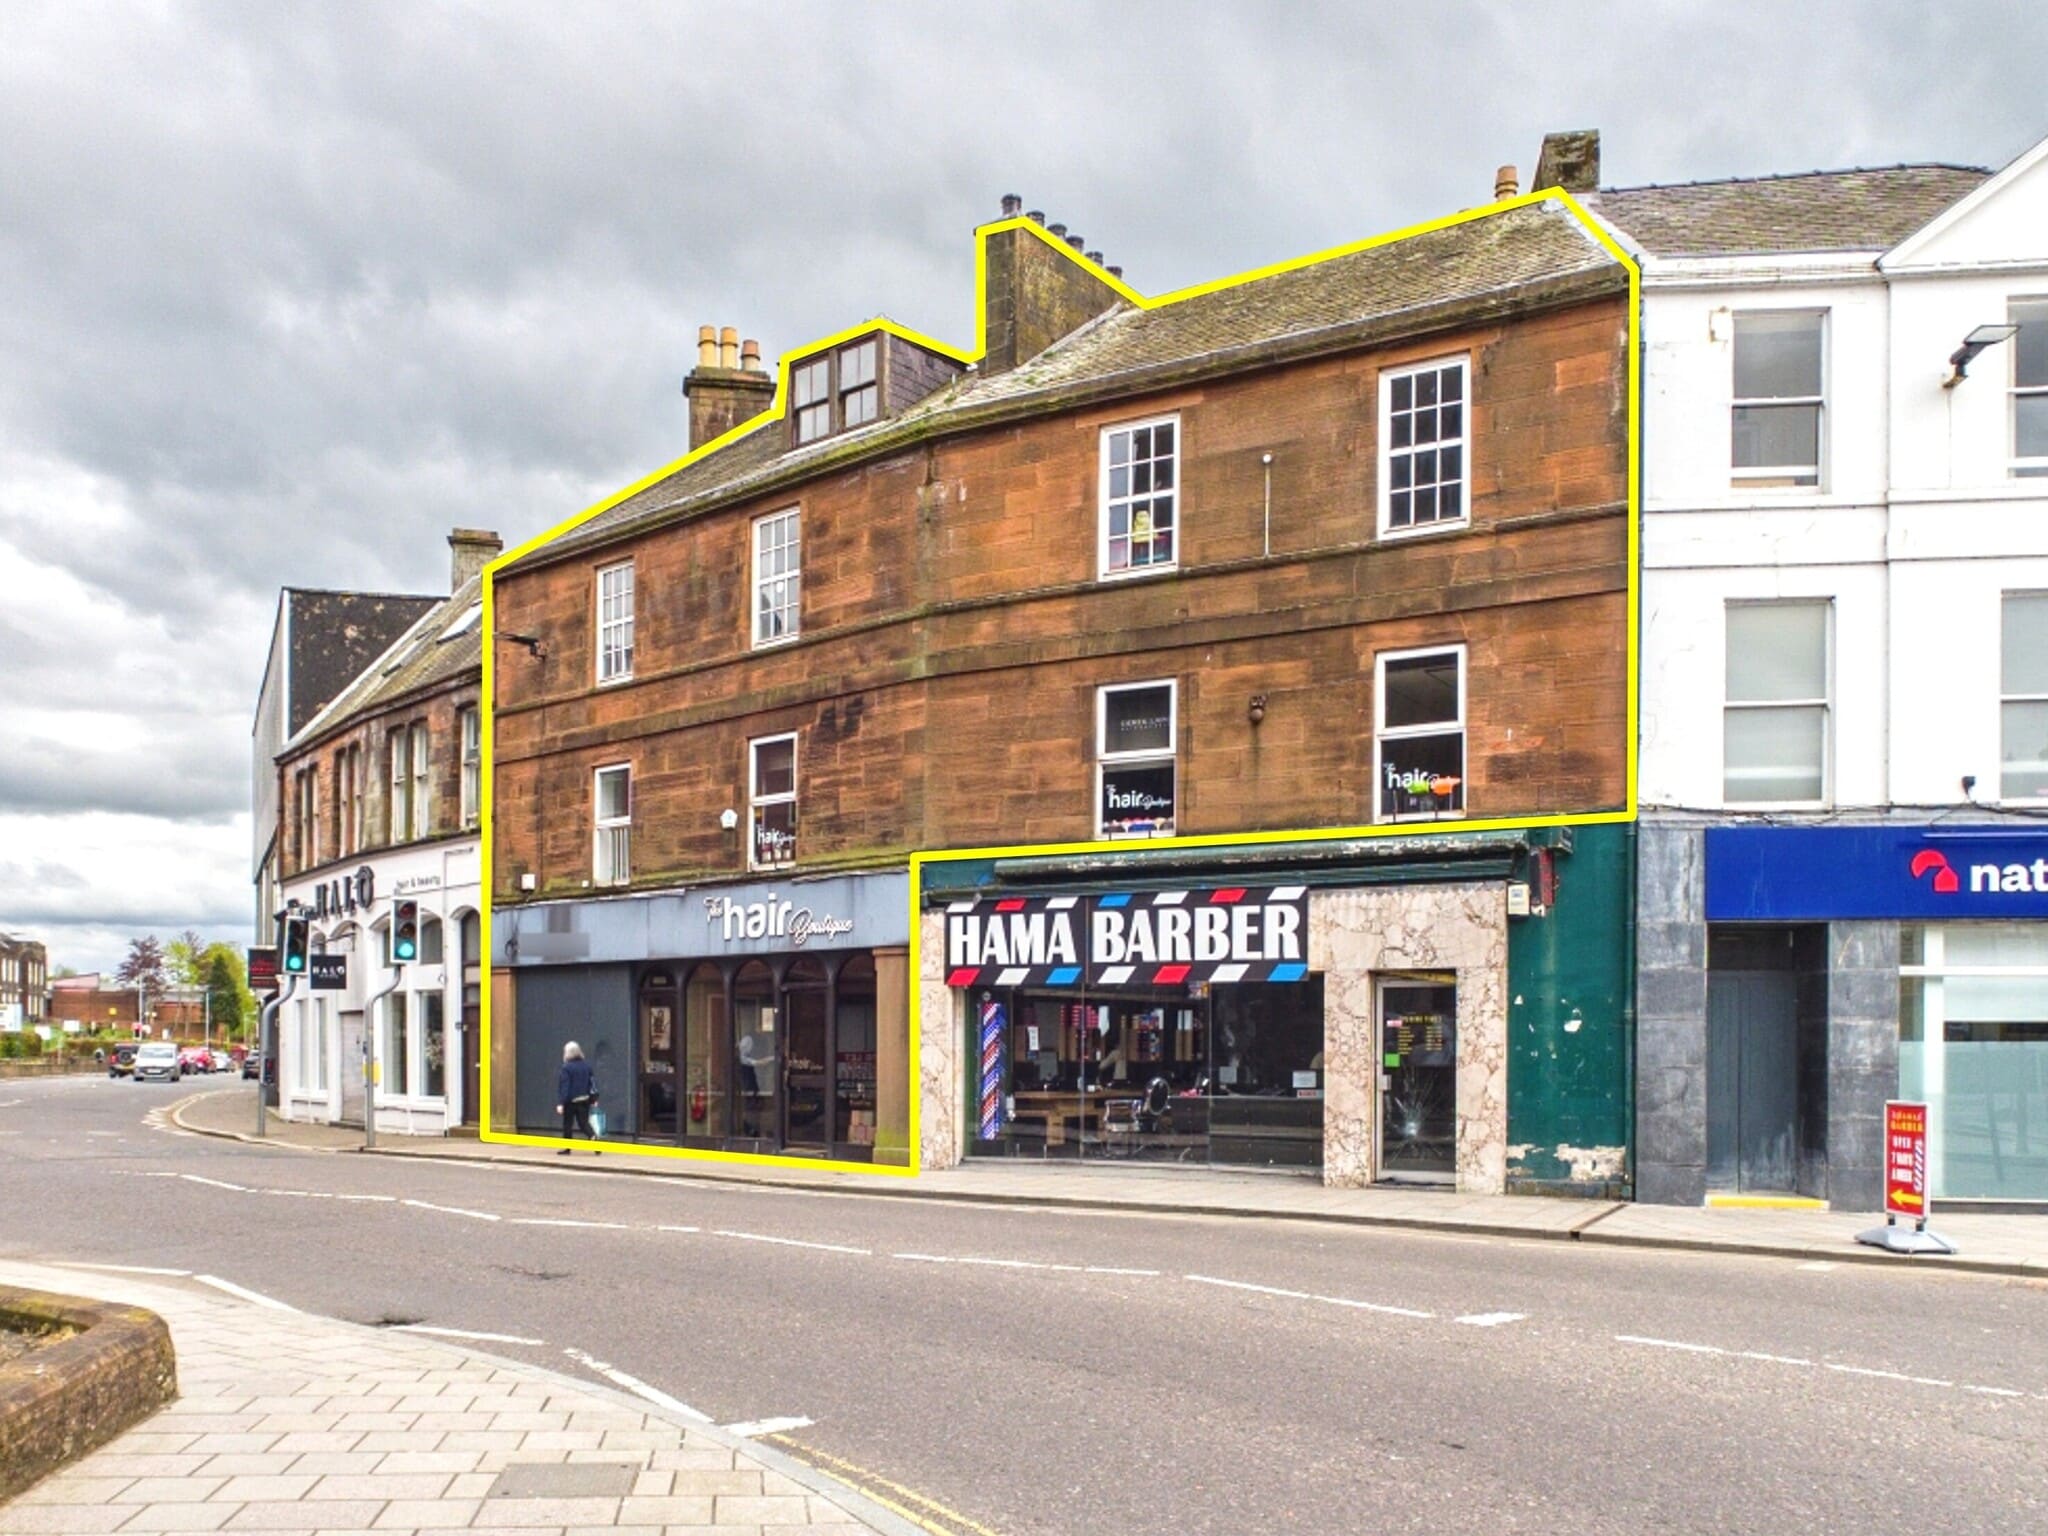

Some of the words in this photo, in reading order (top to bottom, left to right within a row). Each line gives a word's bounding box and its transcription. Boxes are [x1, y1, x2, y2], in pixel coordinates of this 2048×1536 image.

[1108, 790, 1143, 809] hair
[724, 893, 792, 940] hair
[789, 907, 853, 944] Boutique
[949, 912, 1077, 965] HAMA
[1093, 904, 1300, 963] BARBER
